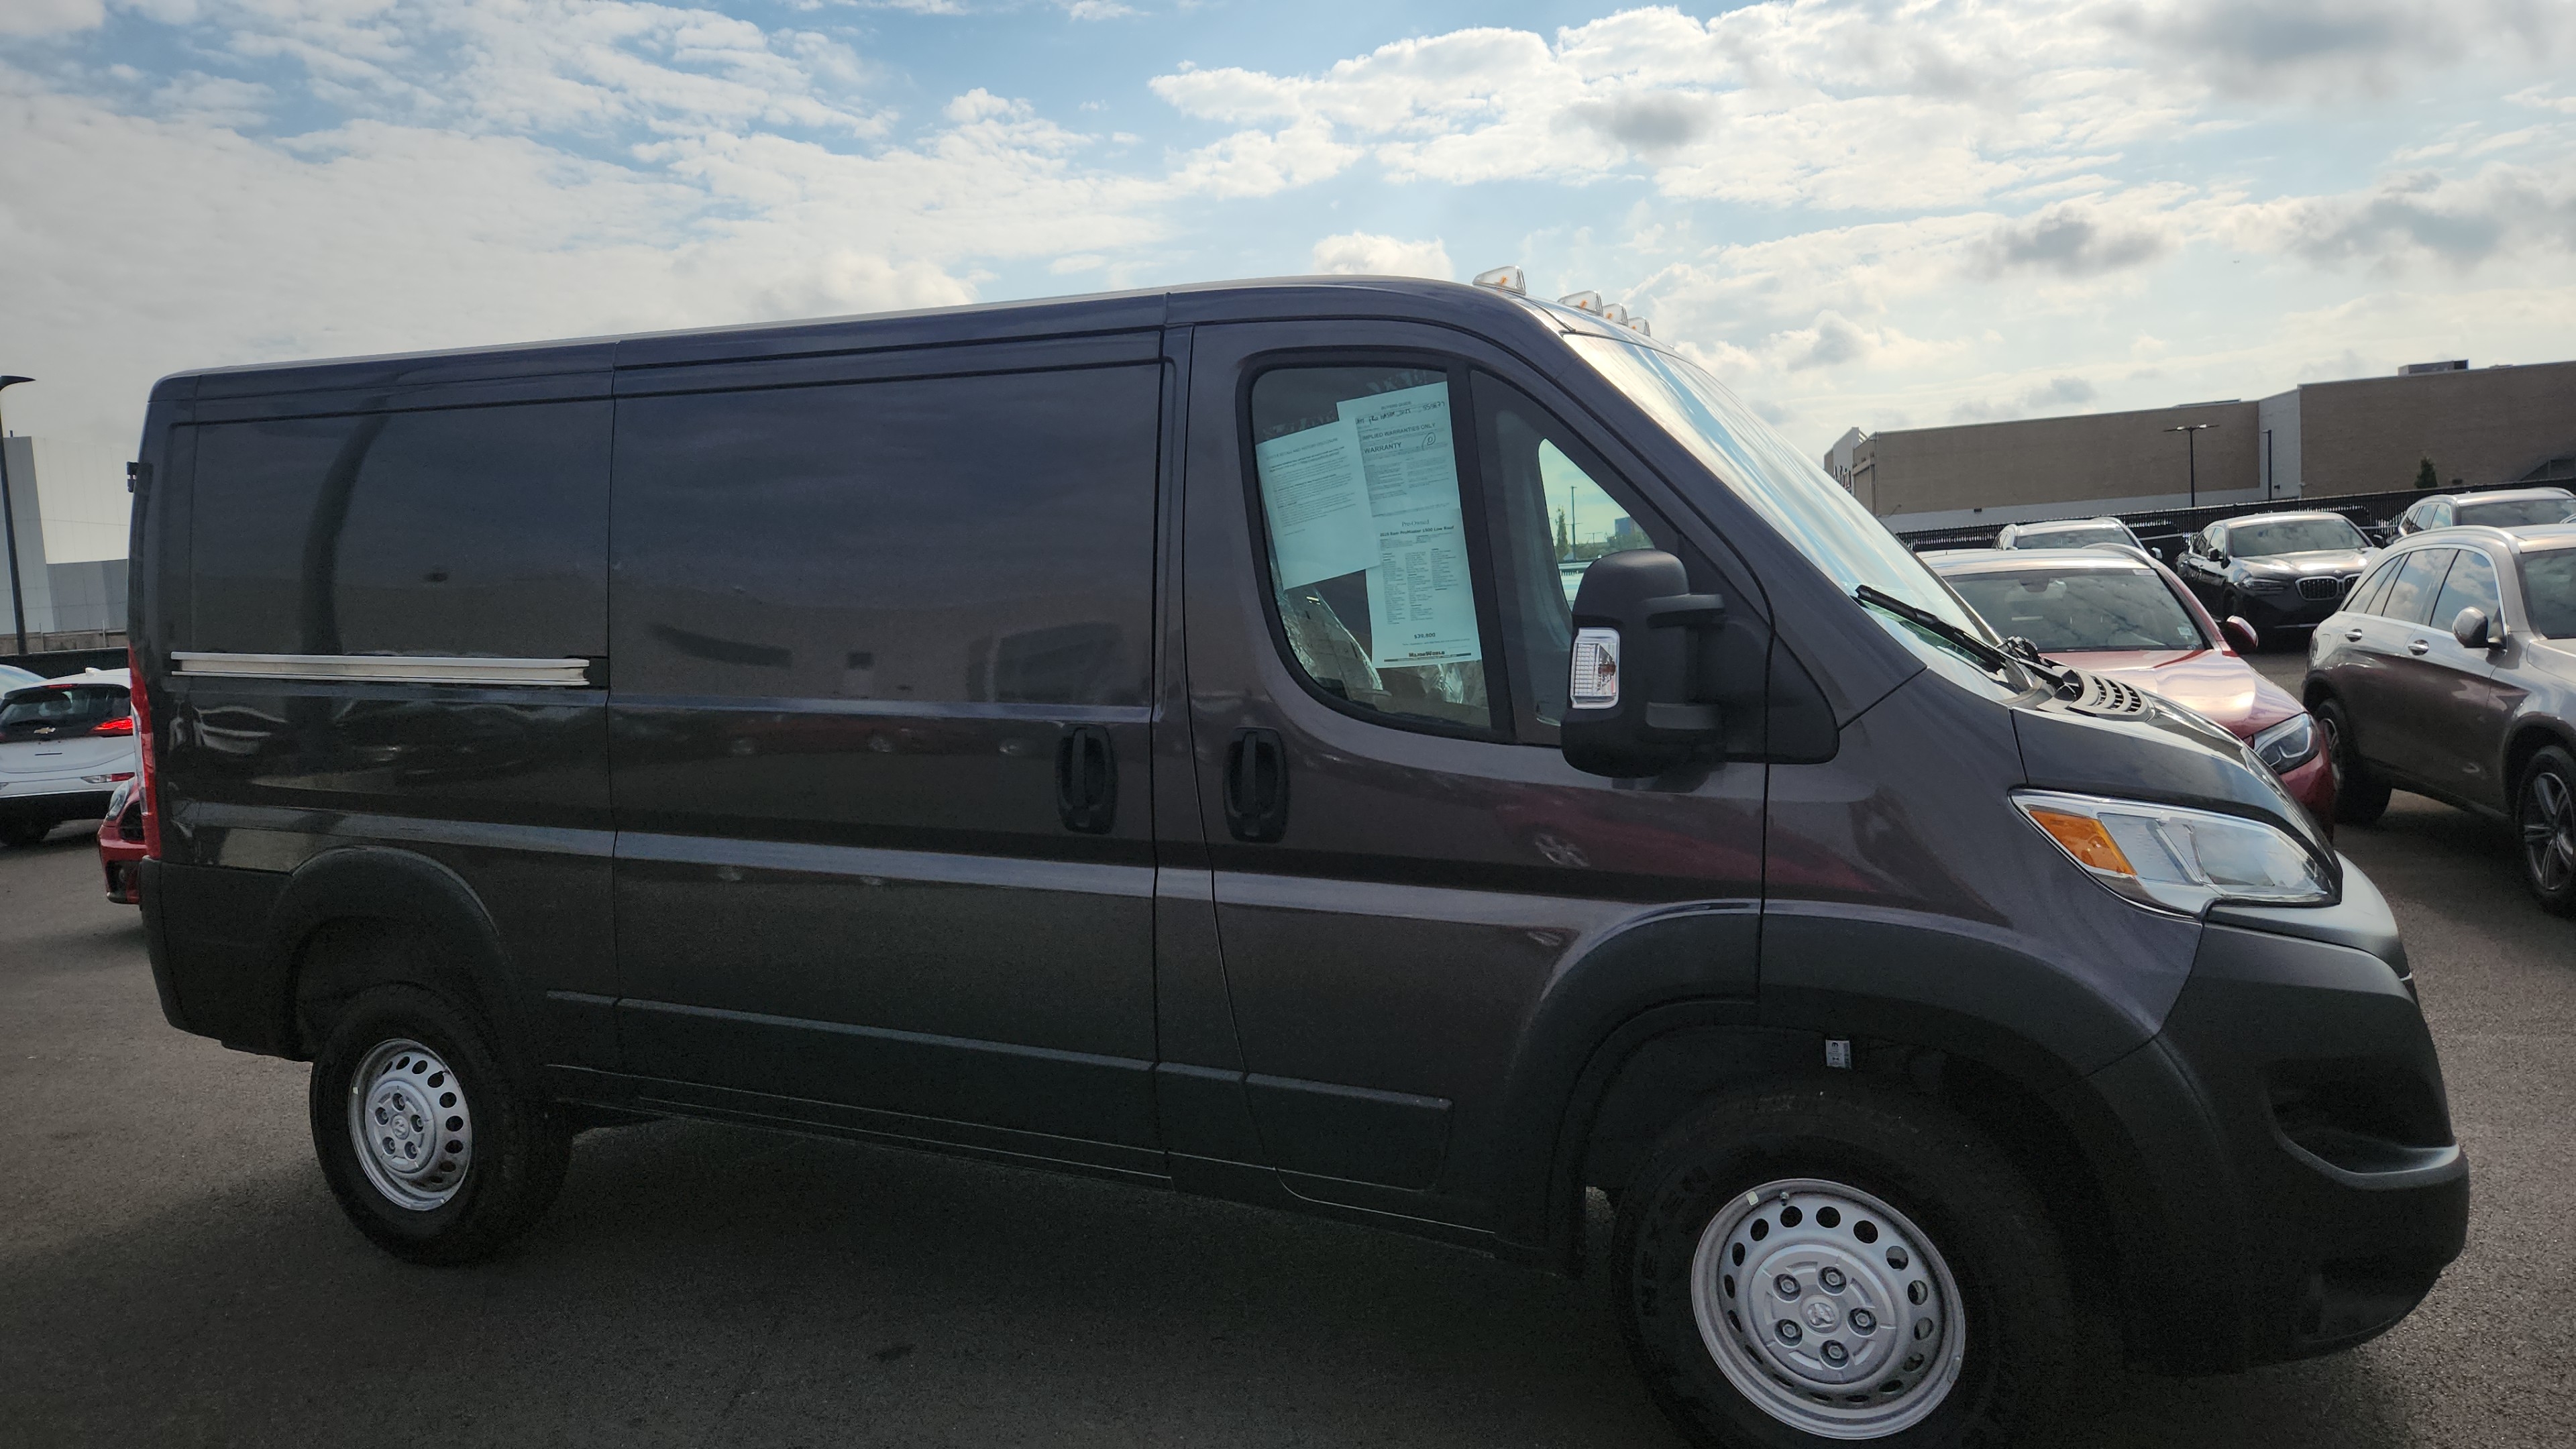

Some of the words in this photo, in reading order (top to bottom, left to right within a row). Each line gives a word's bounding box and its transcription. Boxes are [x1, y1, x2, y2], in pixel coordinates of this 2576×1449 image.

[1362, 433, 1383, 441] IMPLIED
[1384, 425, 1419, 436] WARRANTIES
[1363, 441, 1402, 454] WARRANTY
